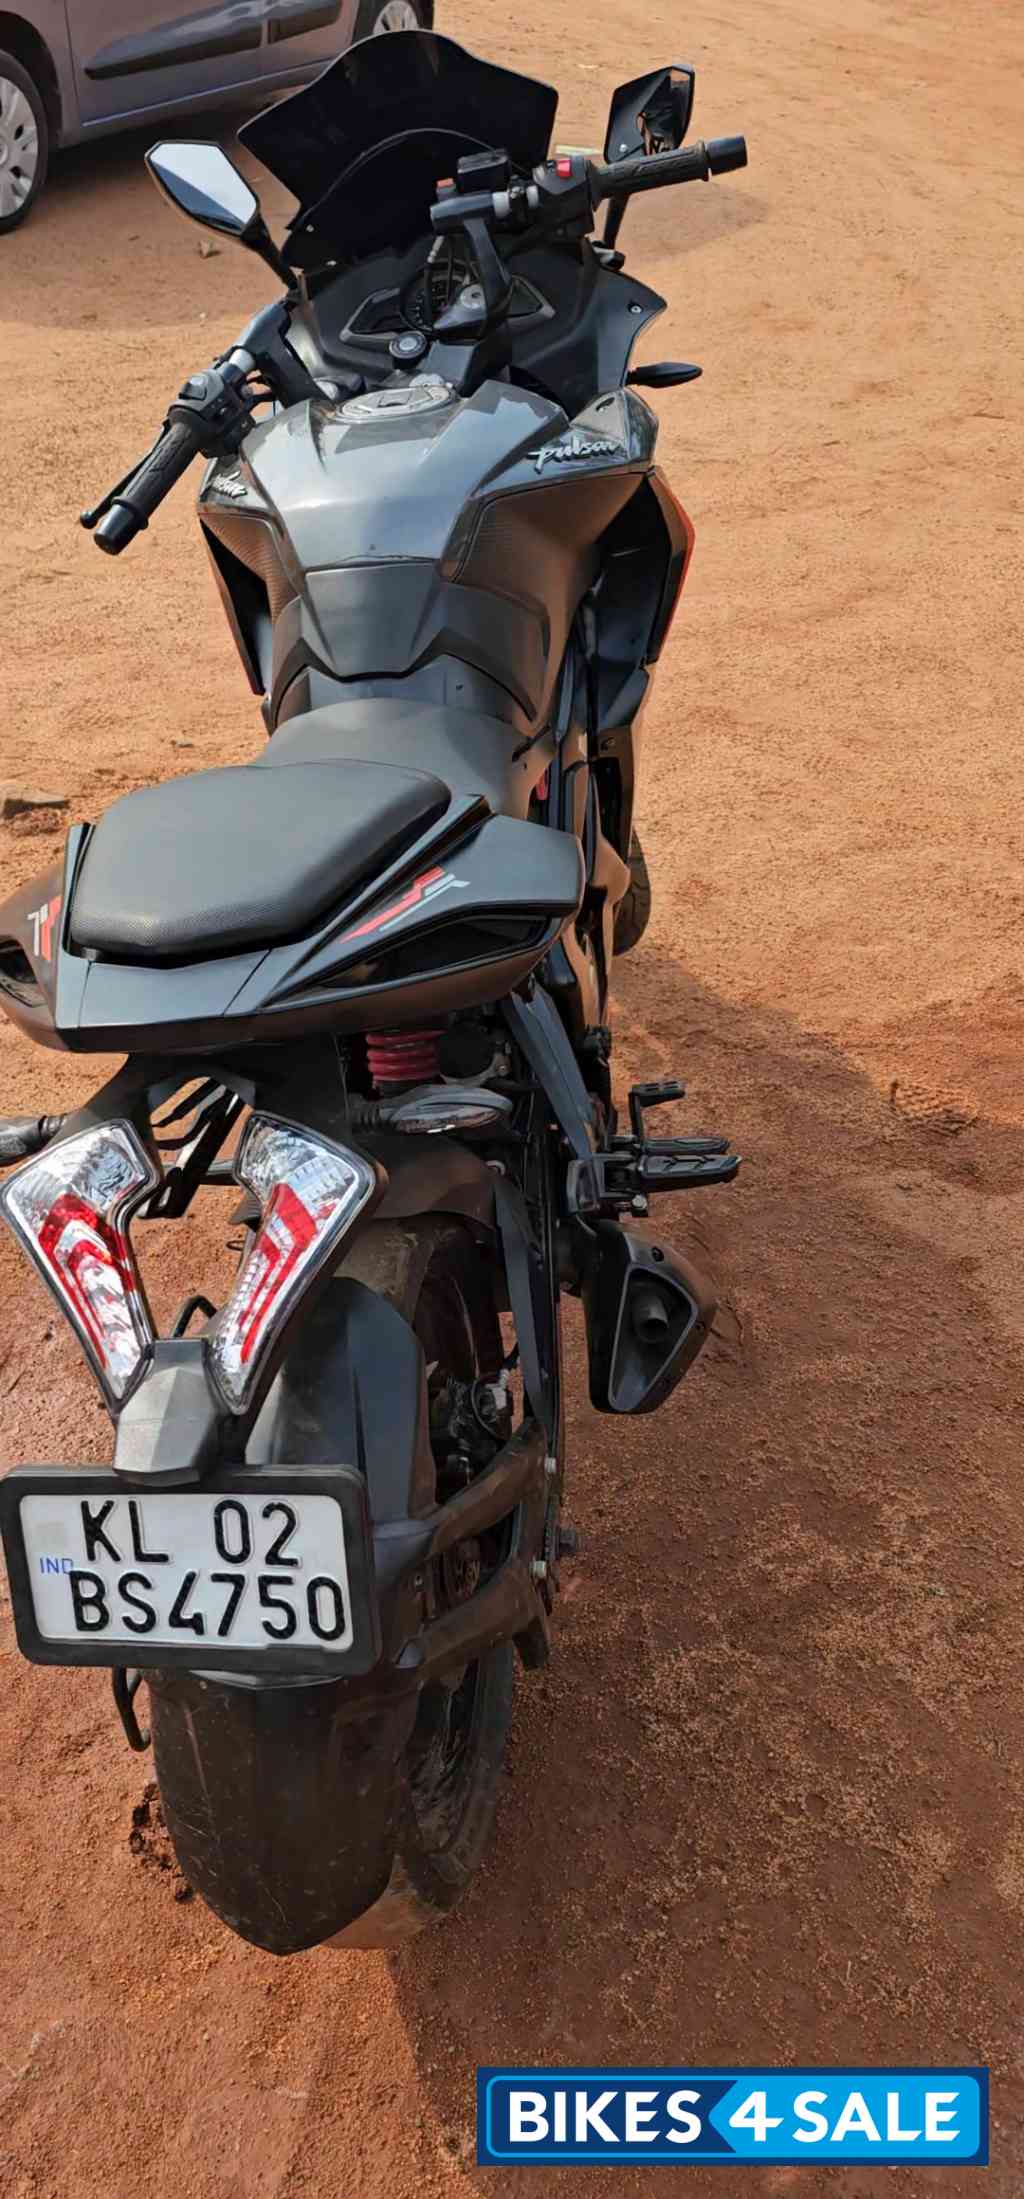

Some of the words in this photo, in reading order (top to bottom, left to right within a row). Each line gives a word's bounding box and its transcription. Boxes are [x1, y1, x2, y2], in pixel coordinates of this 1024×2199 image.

[40, 1557, 74, 1575] IND
[80, 1500, 169, 1562] KL
[213, 1499, 299, 1567] 02
[70, 1570, 346, 1641] BS4750
